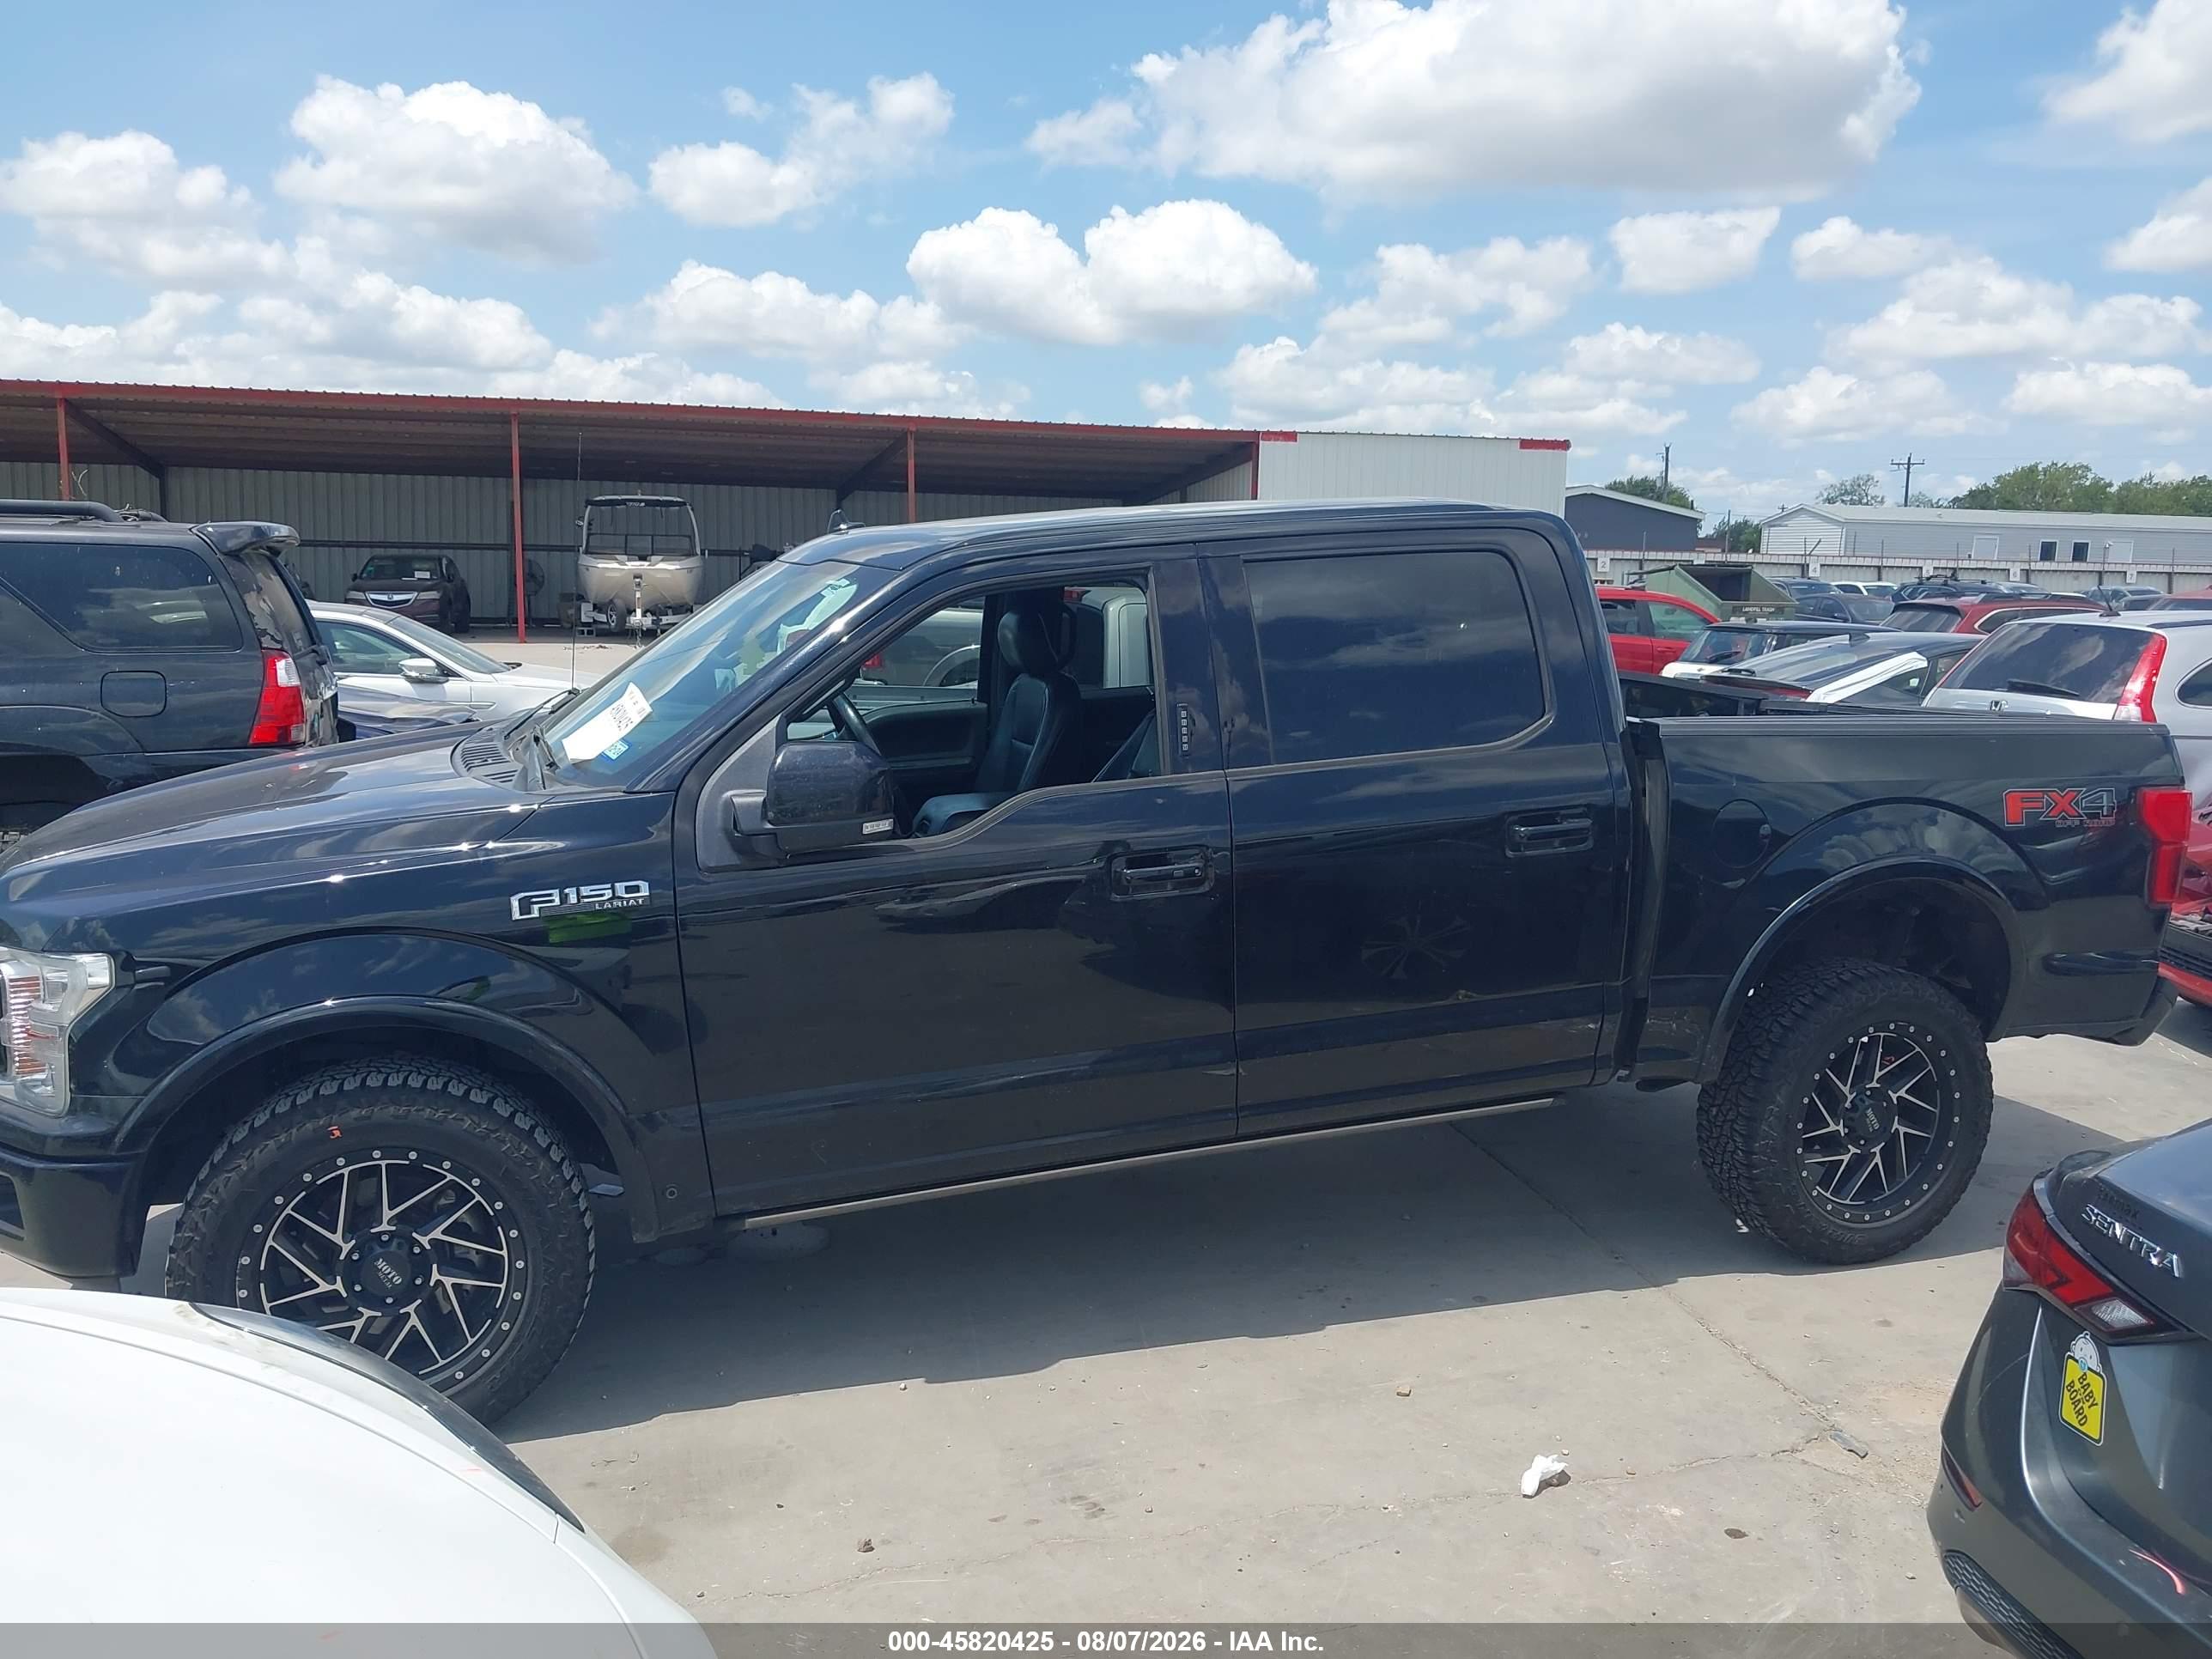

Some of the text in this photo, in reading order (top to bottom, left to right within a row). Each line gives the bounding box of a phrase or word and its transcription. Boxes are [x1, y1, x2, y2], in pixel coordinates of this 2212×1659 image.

[2002, 787, 2117, 827] FX4
[594, 898, 645, 910] LARIAT
[2081, 1203, 2182, 1278] SENTRA
[374, 1257, 402, 1285] MOTO
[2065, 1379, 2087, 1426] BOARD
[2077, 1372, 2098, 1409] BABY
